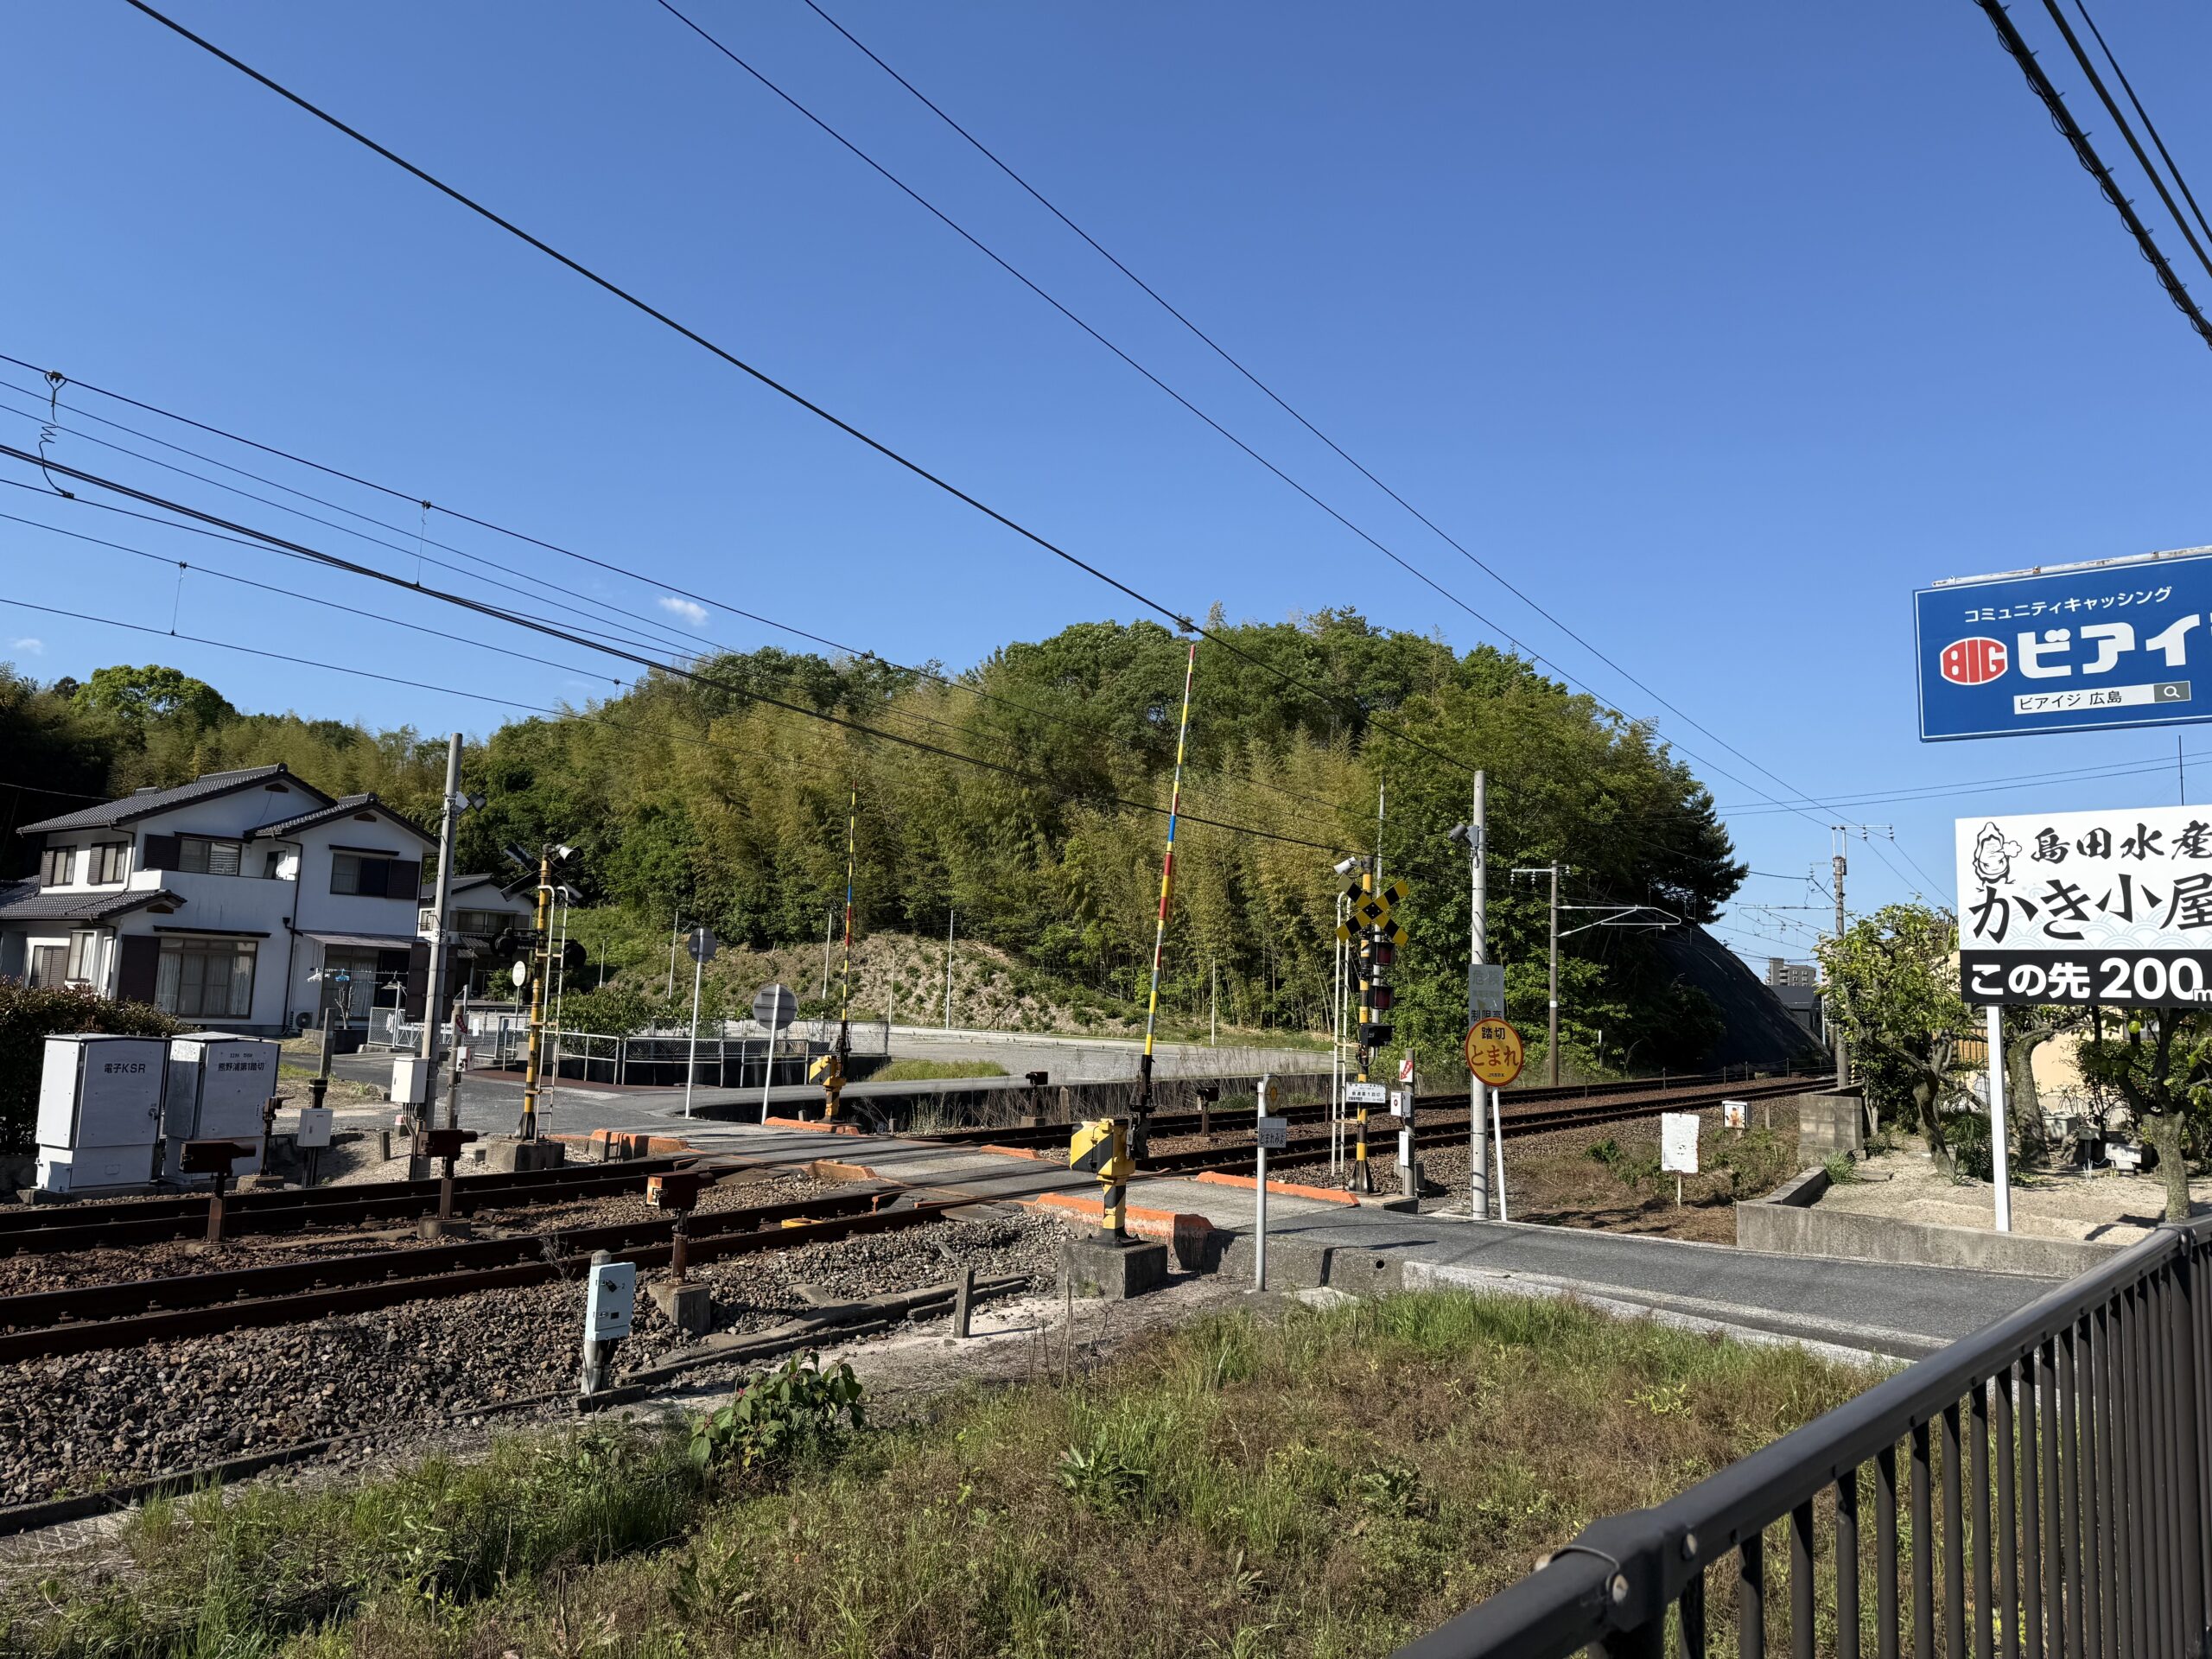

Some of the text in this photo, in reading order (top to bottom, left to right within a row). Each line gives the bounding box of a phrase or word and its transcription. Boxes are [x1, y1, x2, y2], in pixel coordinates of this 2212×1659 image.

[1964, 586, 2172, 623] コミュニティキャッシング
[2018, 613, 2212, 679] ビアイ
[1942, 639, 2006, 683] BIG
[2019, 690, 2122, 710] ビアイジ 広島
[1969, 873, 2212, 944] かき小屋
[1481, 1027, 1505, 1039] 踏切
[1471, 1044, 1519, 1067] とまれ
[104, 1063, 146, 1074] 電子KSR
[1260, 1133, 1284, 1145] とまれみよ
